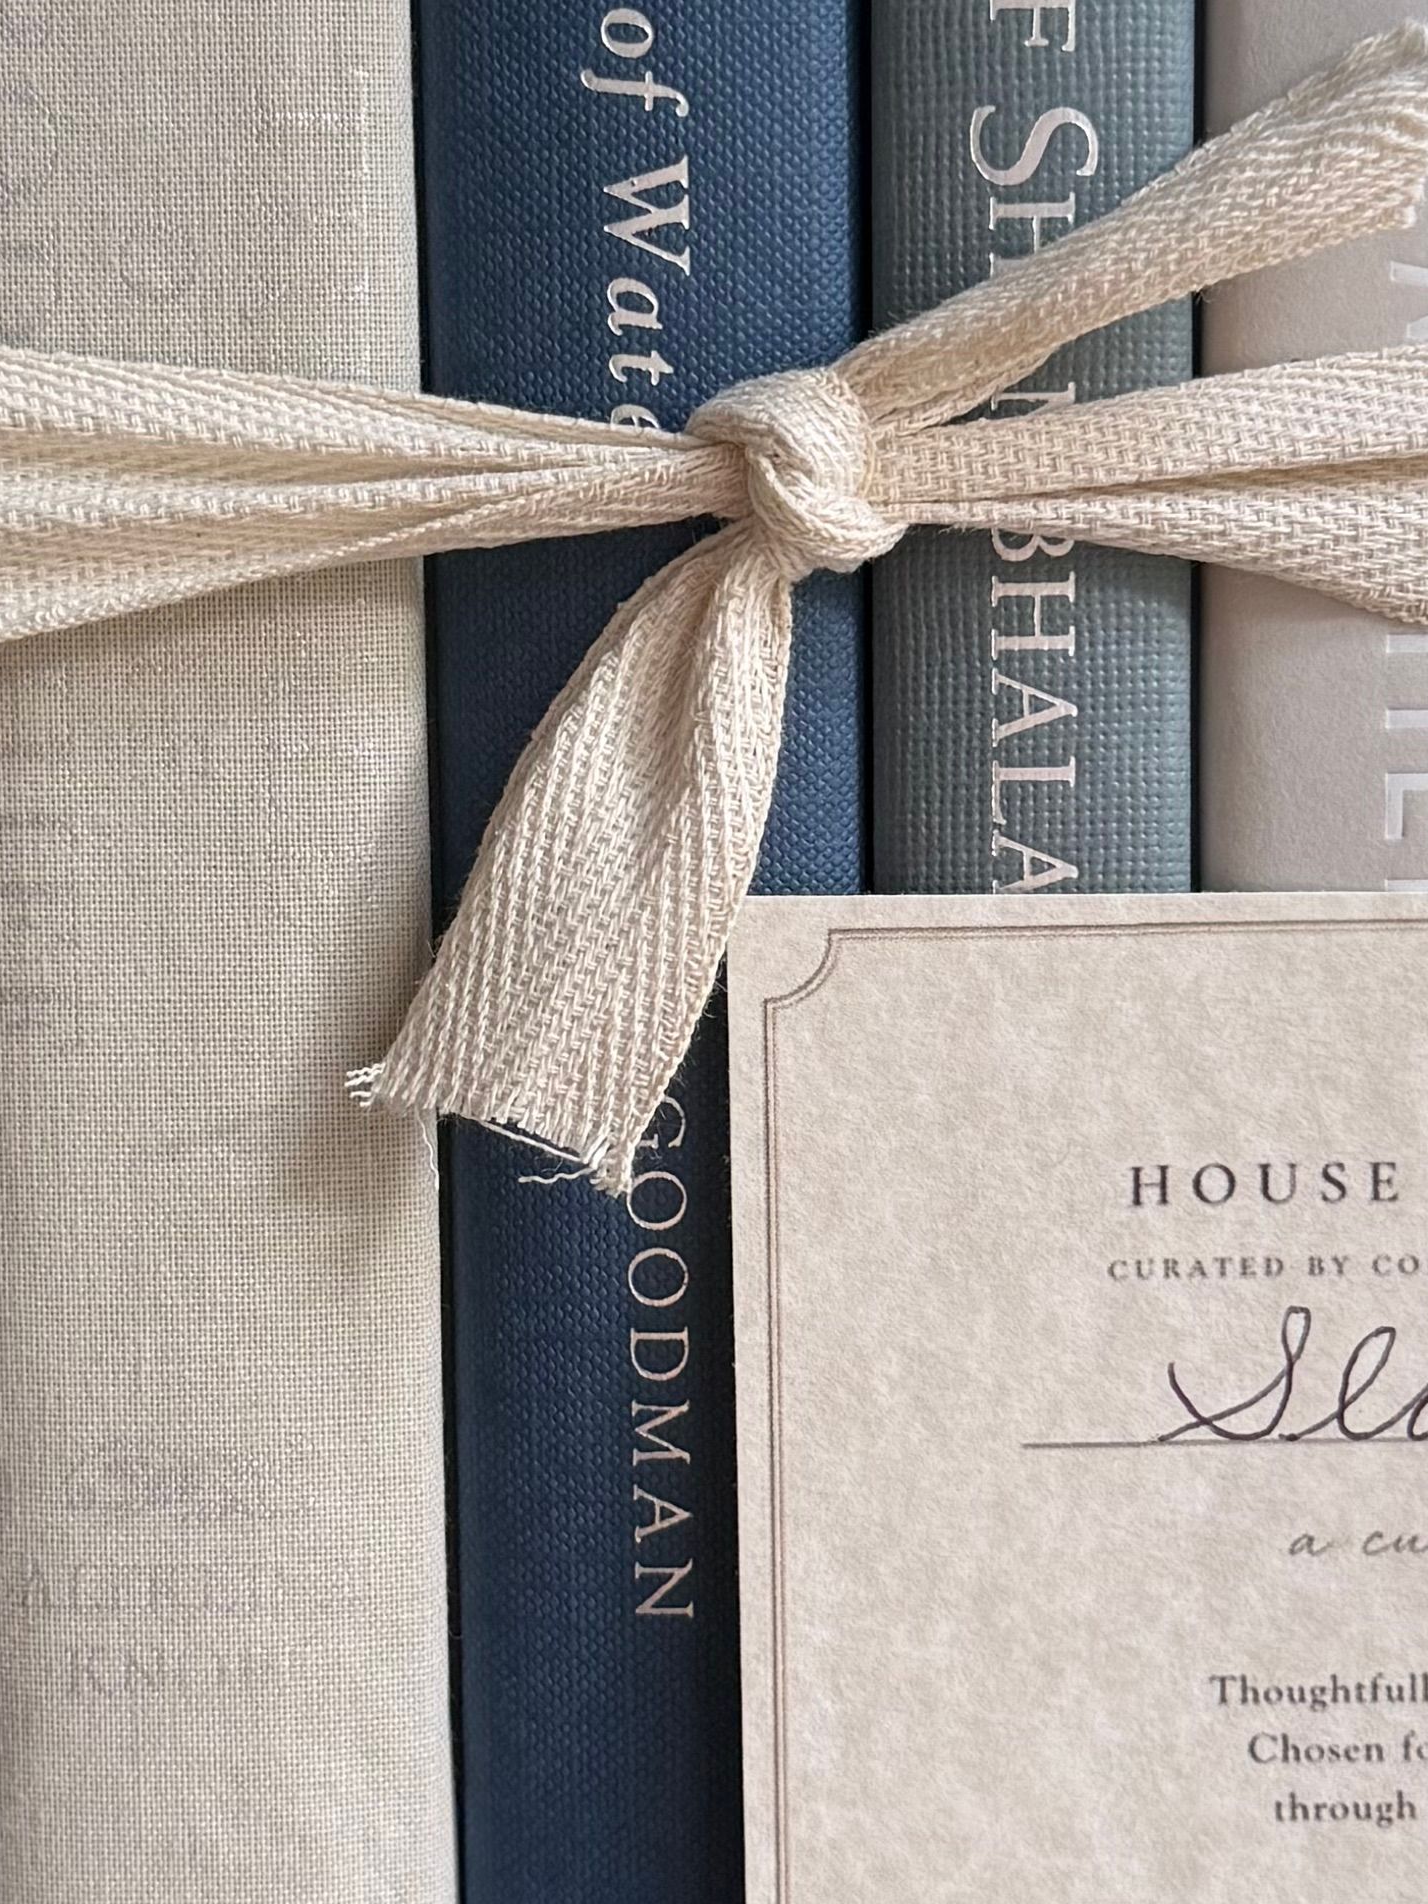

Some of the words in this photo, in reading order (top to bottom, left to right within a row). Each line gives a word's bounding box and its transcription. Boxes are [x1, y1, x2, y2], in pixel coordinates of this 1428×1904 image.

[580, 7, 691, 118] of
[603, 154, 690, 430] Wate
[969, 104, 1098, 893] SHBHALA
[1129, 1159, 1401, 1210] HOUSE
[1105, 1254, 1287, 1284] CURATED
[1305, 1253, 1351, 1279] BY
[1286, 1526, 1336, 1561] a
[1245, 1730, 1387, 1766] Chosen
[1272, 1787, 1419, 1830] through
